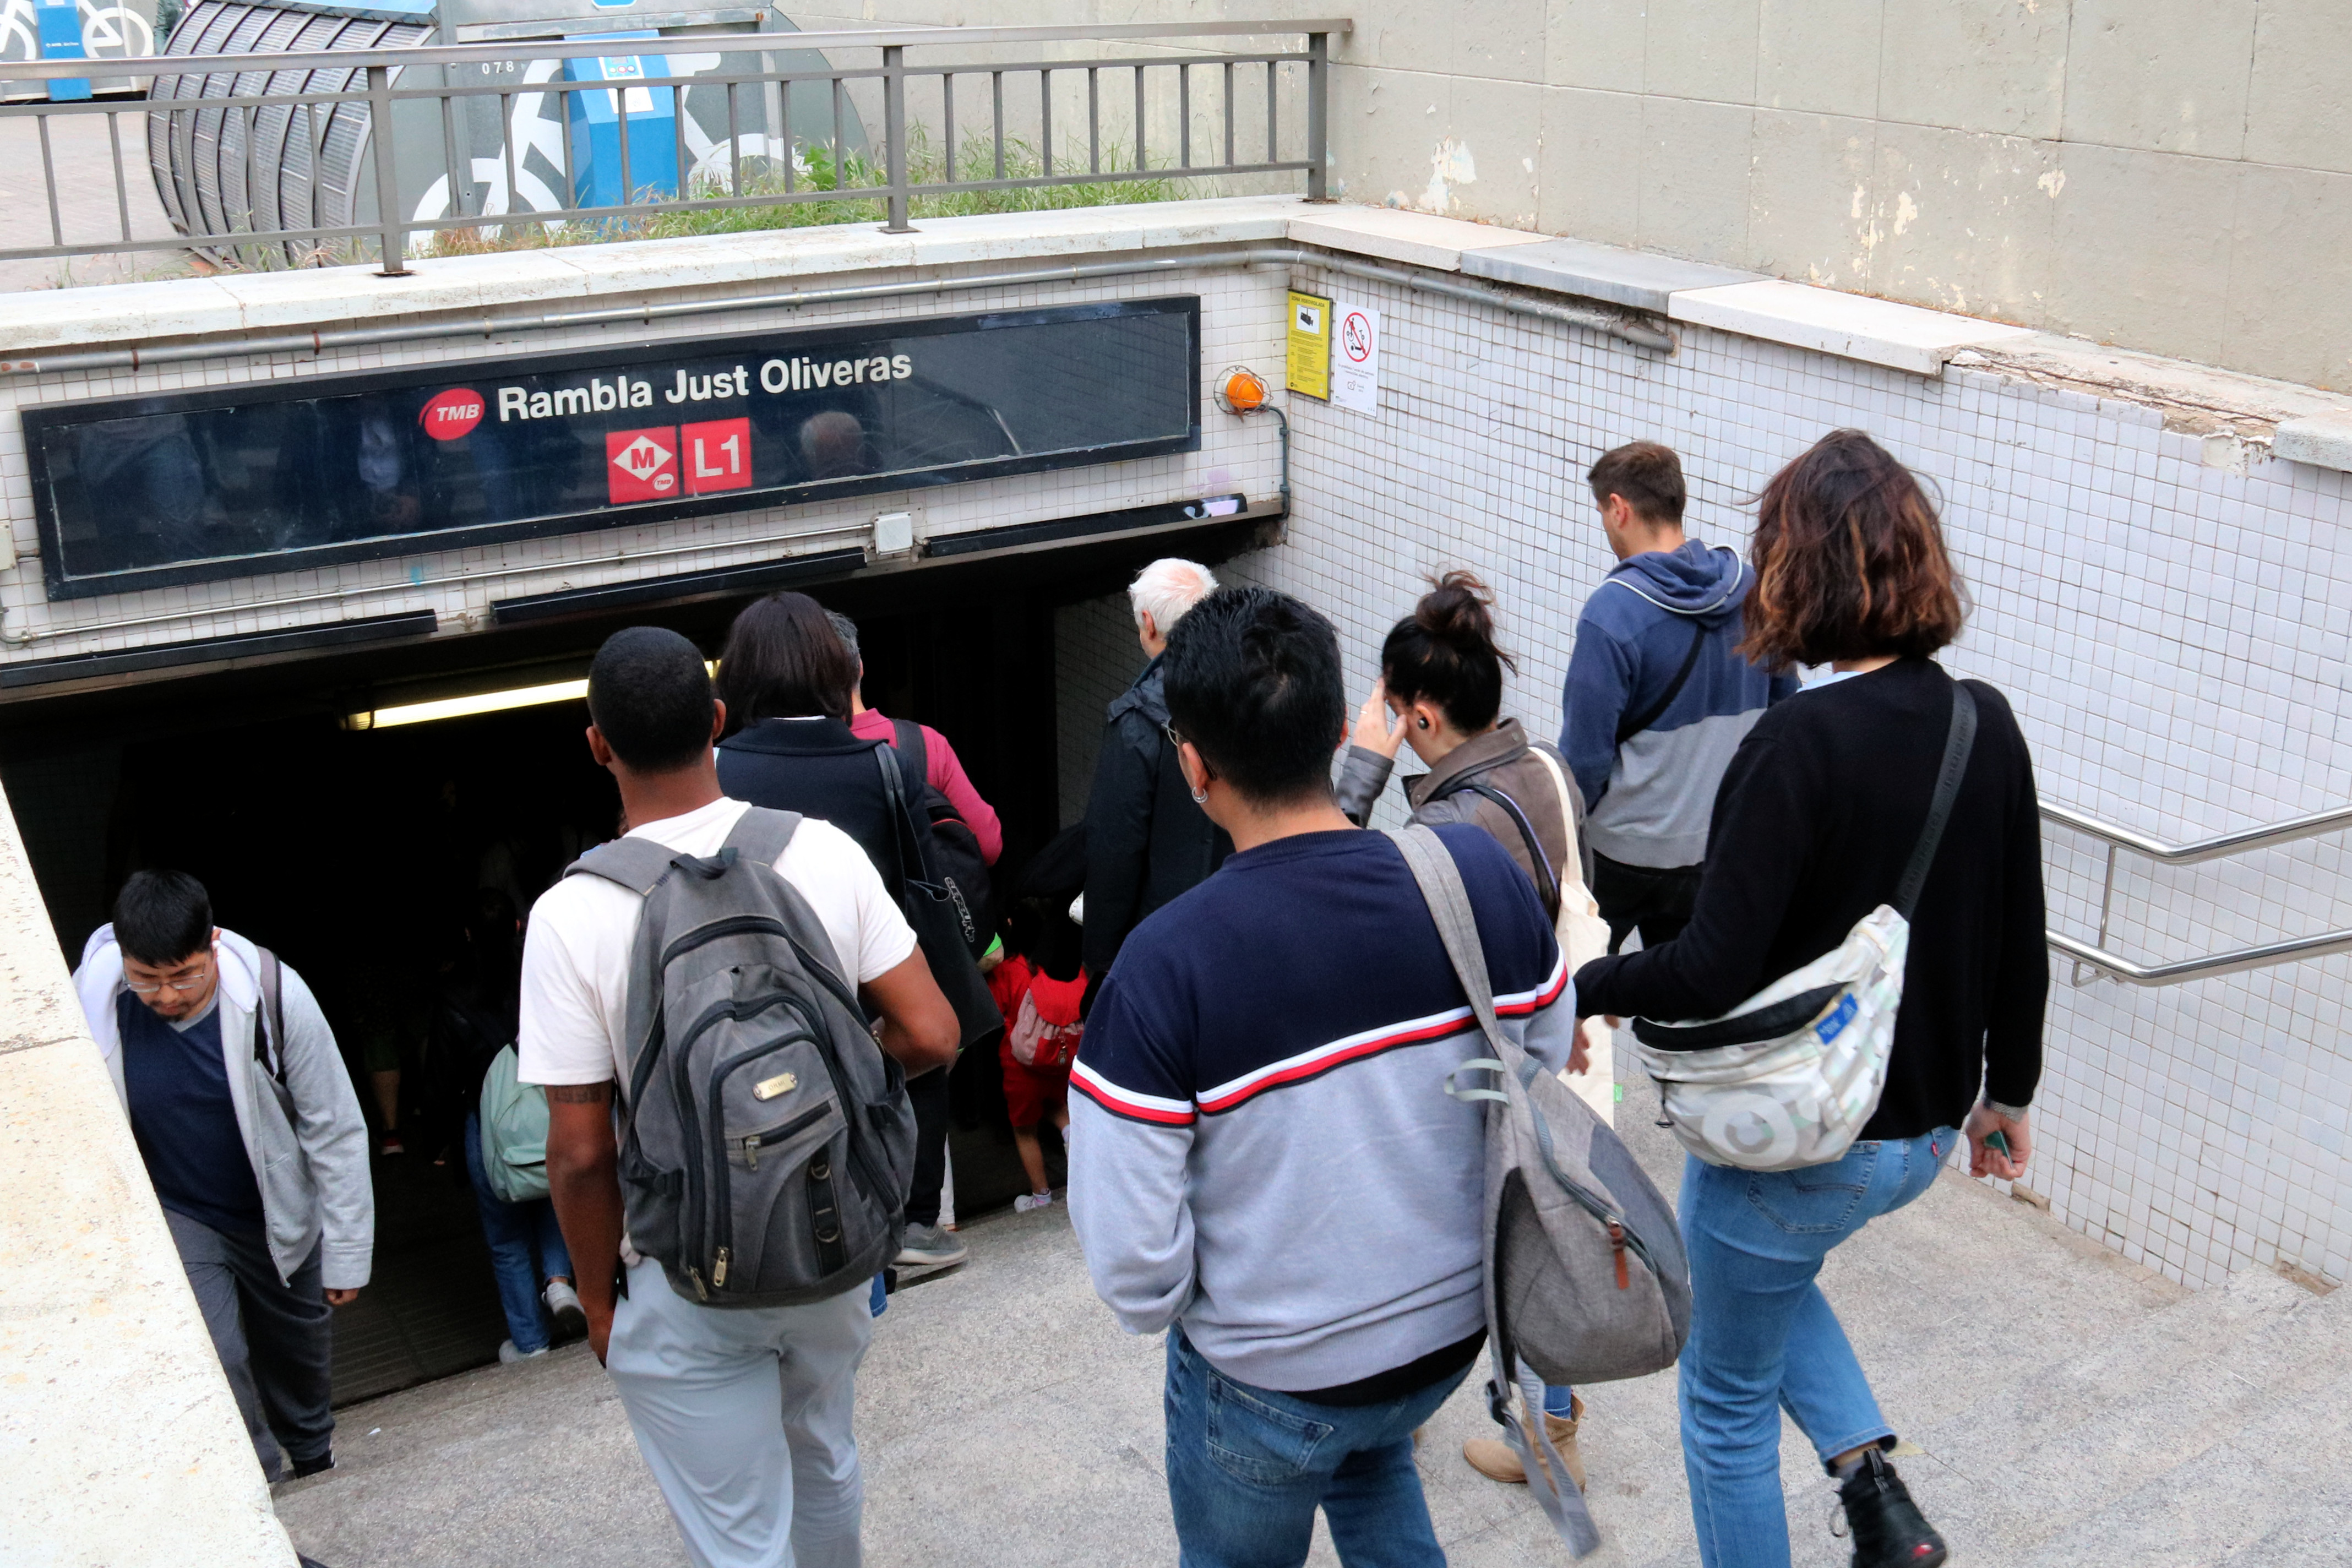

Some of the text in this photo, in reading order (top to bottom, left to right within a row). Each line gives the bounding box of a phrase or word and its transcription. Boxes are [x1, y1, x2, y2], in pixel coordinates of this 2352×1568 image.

[482, 61, 514, 74] 078
[498, 353, 913, 422] Rambla Just Oliveras
[436, 403, 480, 422] TMB
[630, 447, 655, 470] M
[694, 434, 740, 478] L1
